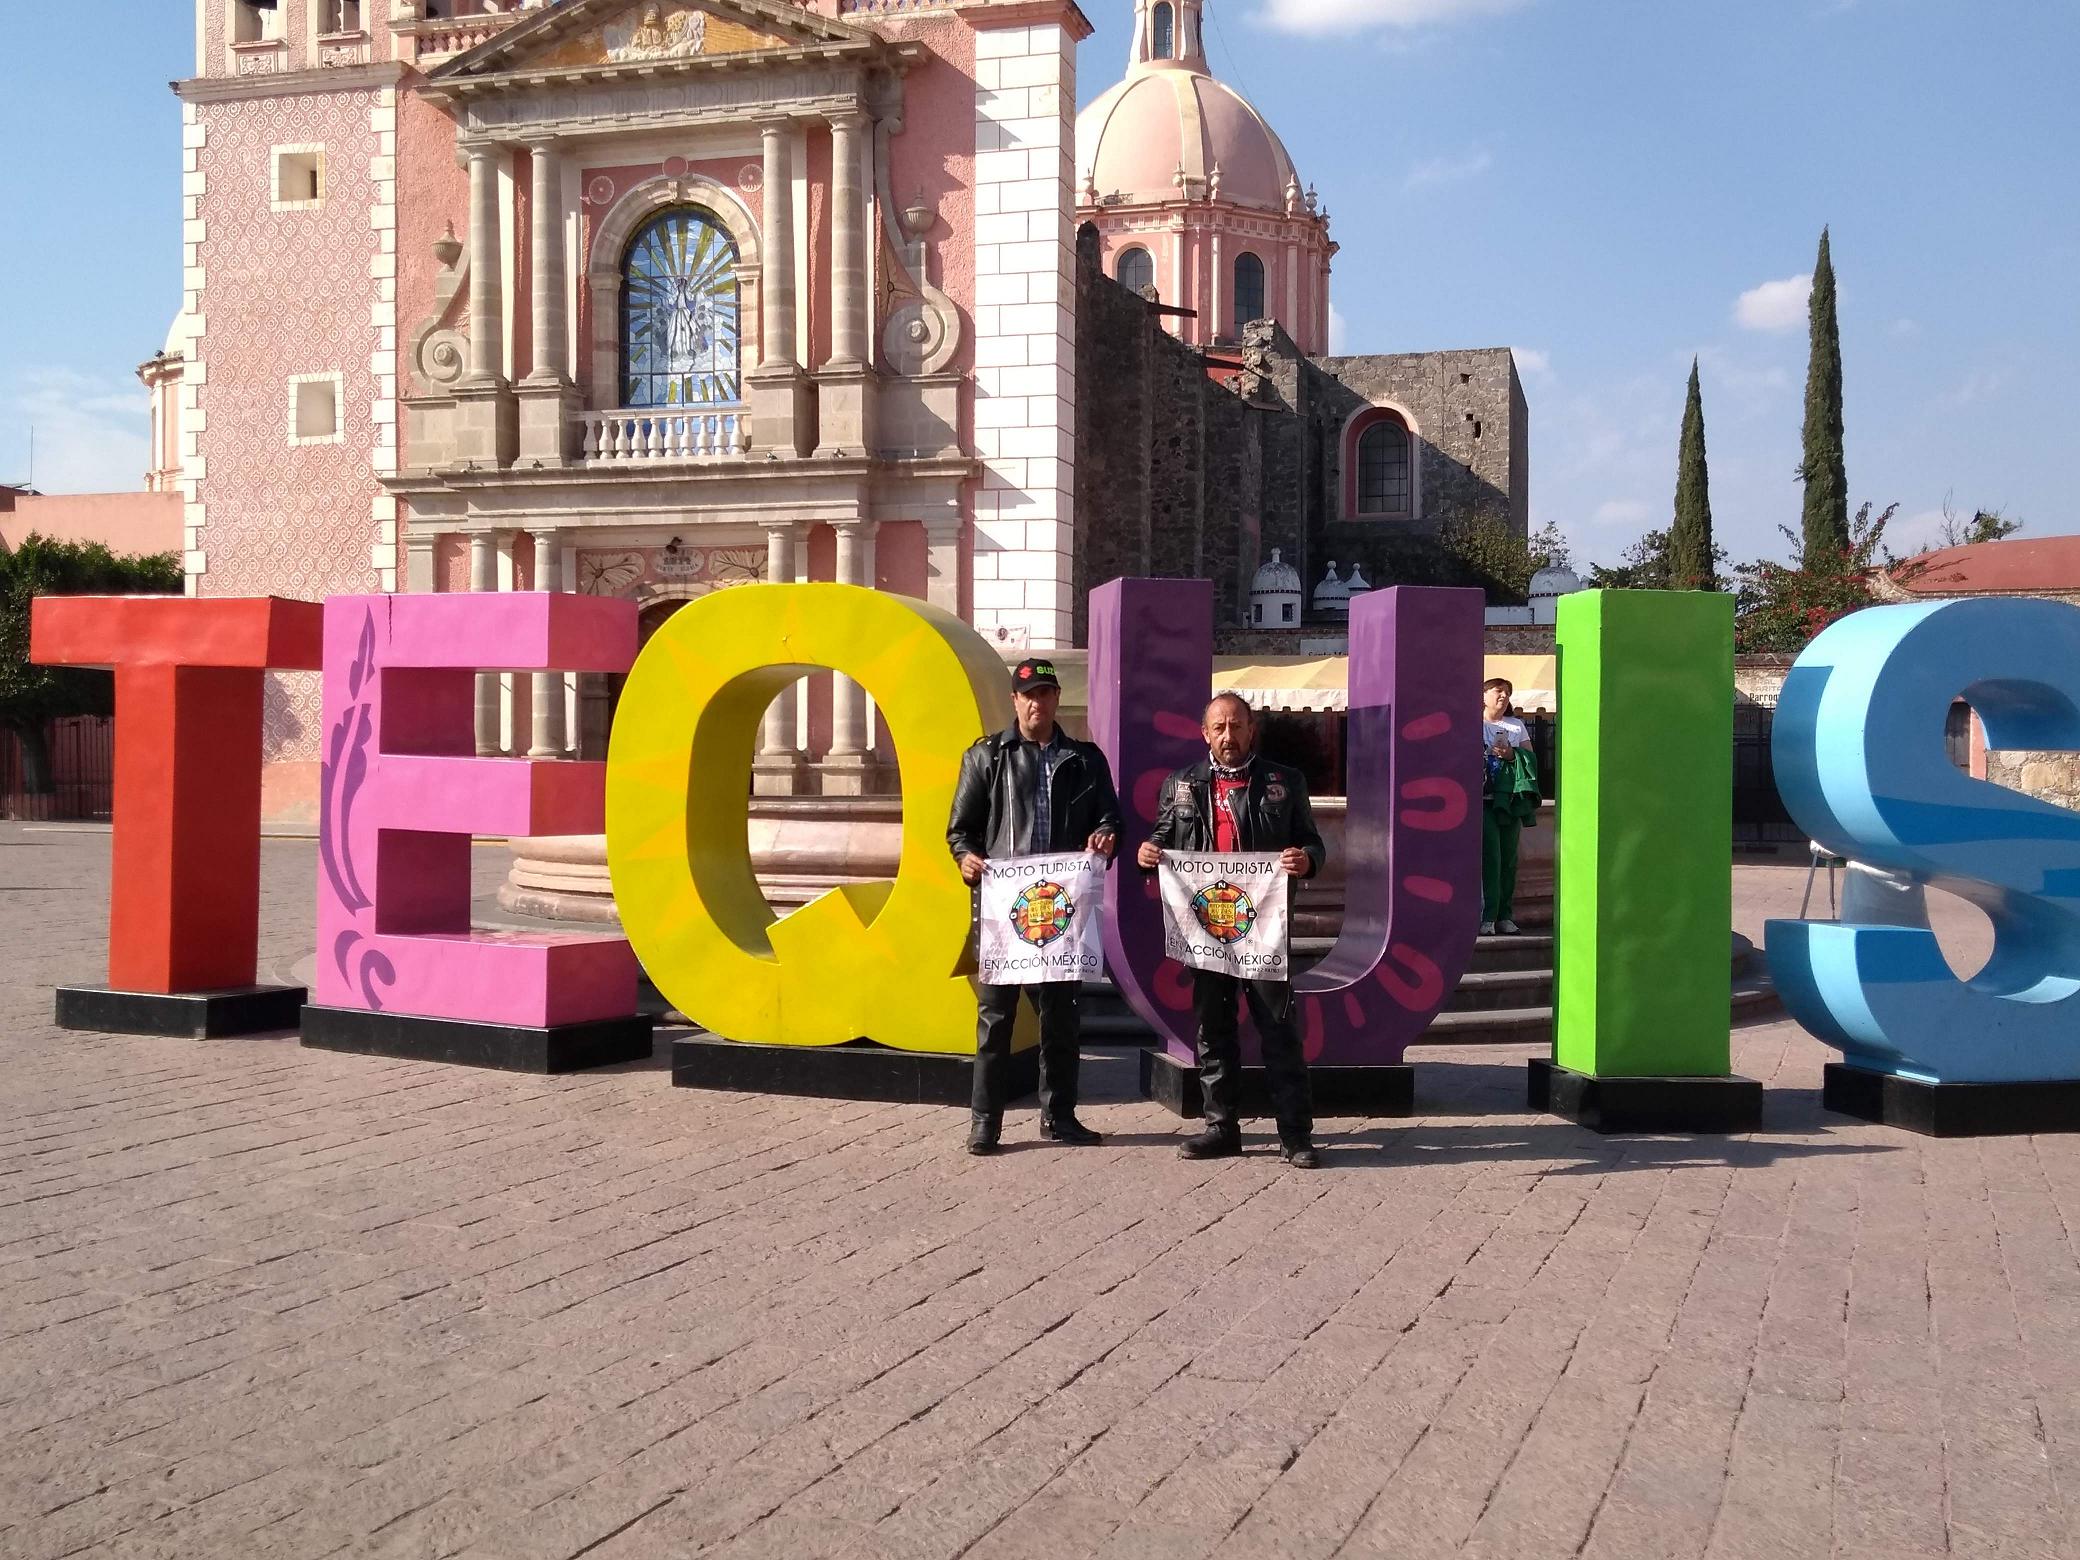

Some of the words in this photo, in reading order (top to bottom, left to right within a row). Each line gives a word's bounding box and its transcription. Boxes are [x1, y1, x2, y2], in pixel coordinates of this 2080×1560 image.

[993, 865, 1036, 879] MOTO
[1039, 860, 1092, 876] TURISTA
[1170, 860, 1214, 874] MOTO
[1218, 861, 1274, 875] TURISTA
[984, 959, 1000, 971] EN
[1003, 953, 1050, 970] ACCIÓN
[1052, 951, 1098, 967] MÉXICO
[1185, 944, 1232, 962] ACCIÓN
[1233, 952, 1282, 967] MÉXICO
